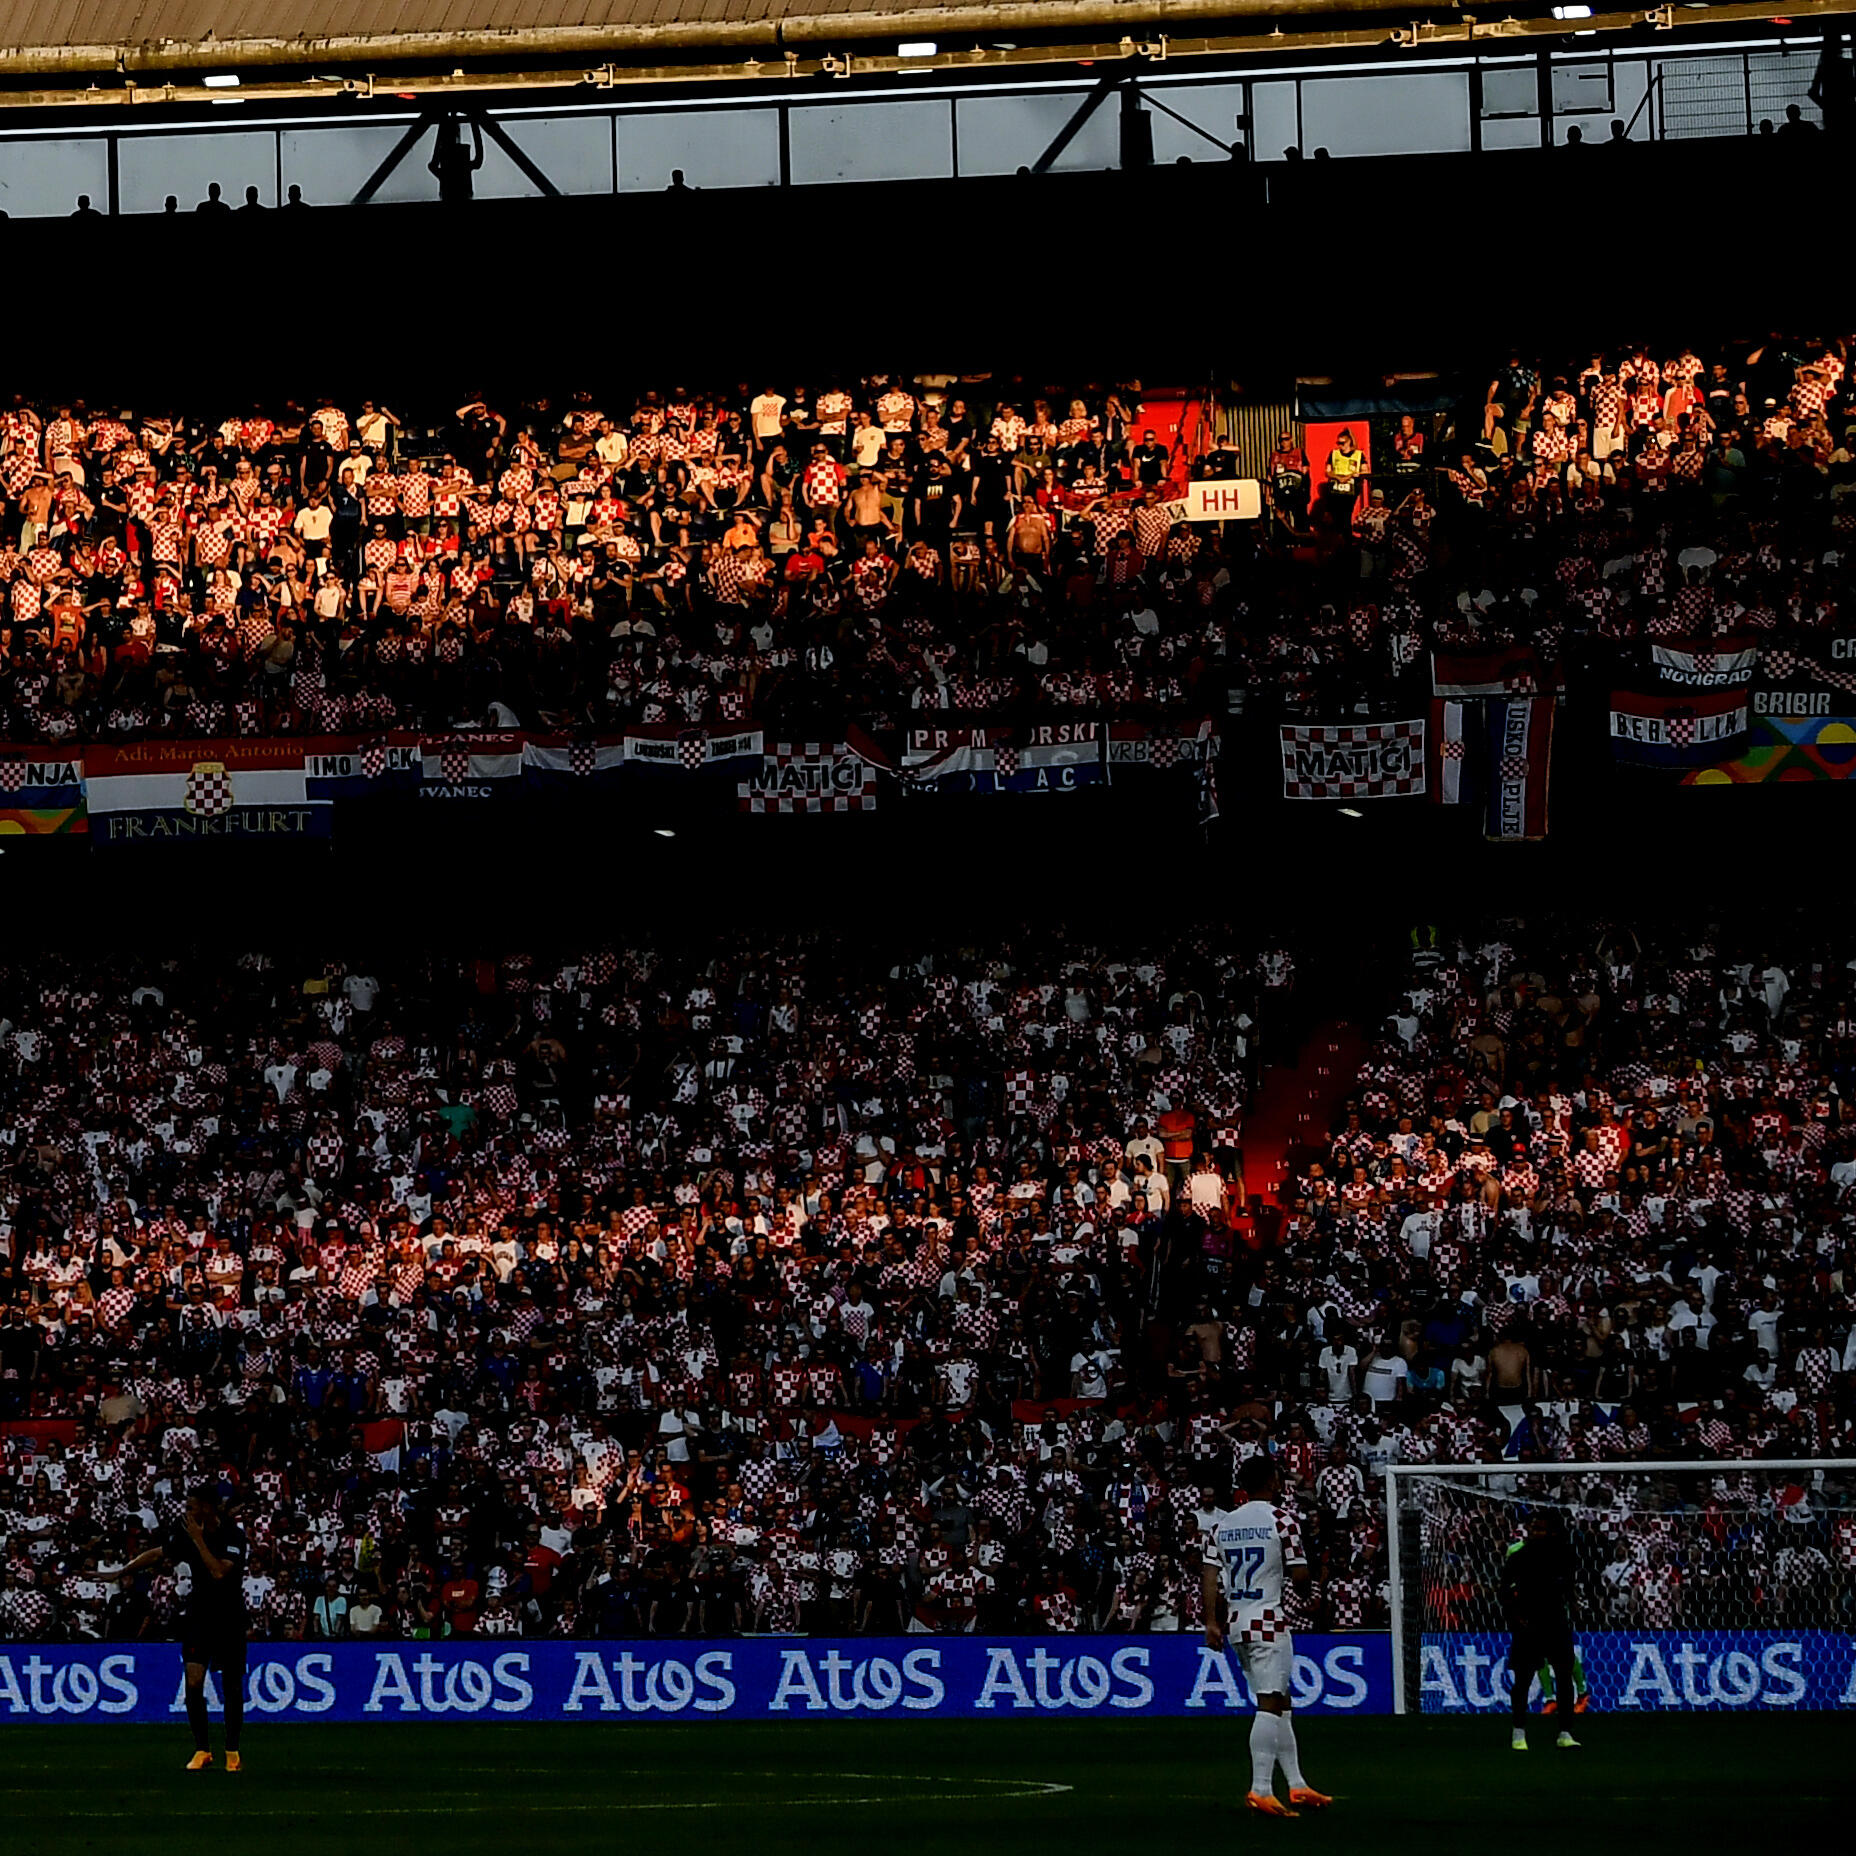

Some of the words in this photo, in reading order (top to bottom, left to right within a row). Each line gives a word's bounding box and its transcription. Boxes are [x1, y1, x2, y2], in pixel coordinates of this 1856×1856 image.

[1202, 489, 1239, 512] HH
[1659, 666, 1753, 686] NOVIGRAD
[1753, 692, 1831, 715] BRIBIR
[108, 810, 313, 840] FRANKFURT
[1224, 1546, 1265, 1600] 22
